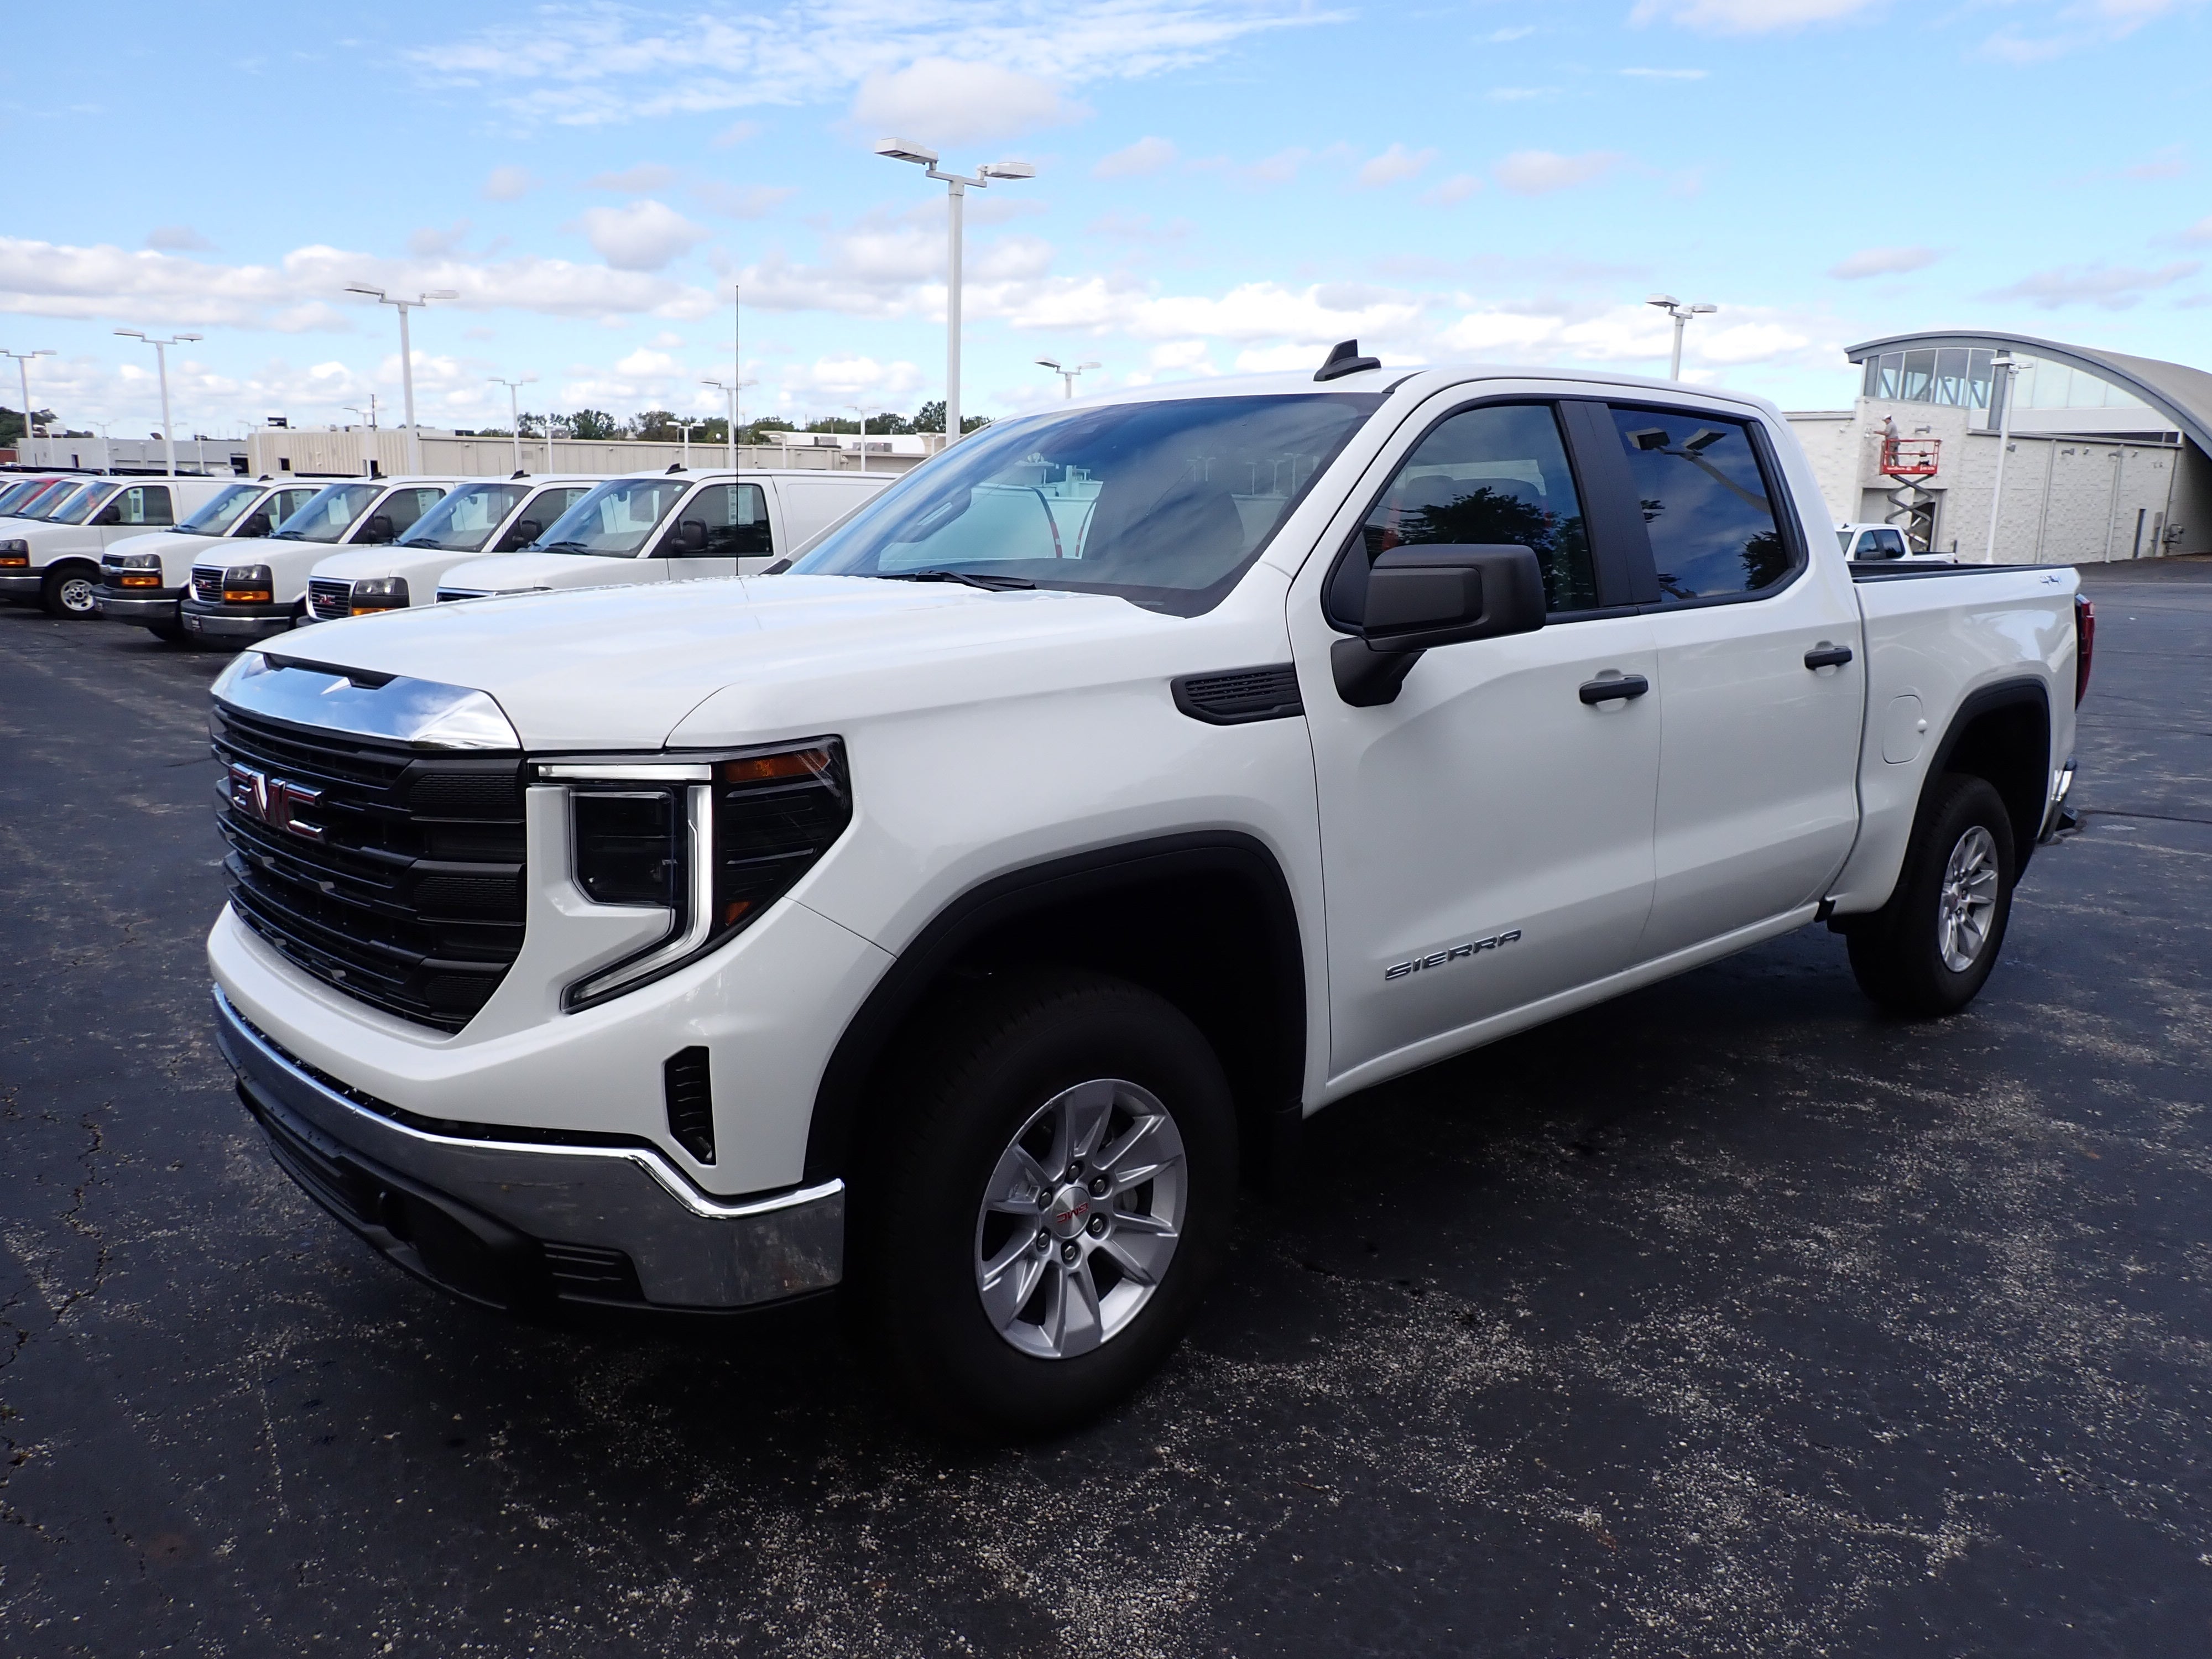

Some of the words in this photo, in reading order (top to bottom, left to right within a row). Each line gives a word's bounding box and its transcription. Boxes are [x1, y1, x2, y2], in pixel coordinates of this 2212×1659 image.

[229, 763, 325, 844] GMC
[1385, 928, 1522, 980] SIERRA
[1056, 1202, 1089, 1224] GMC
